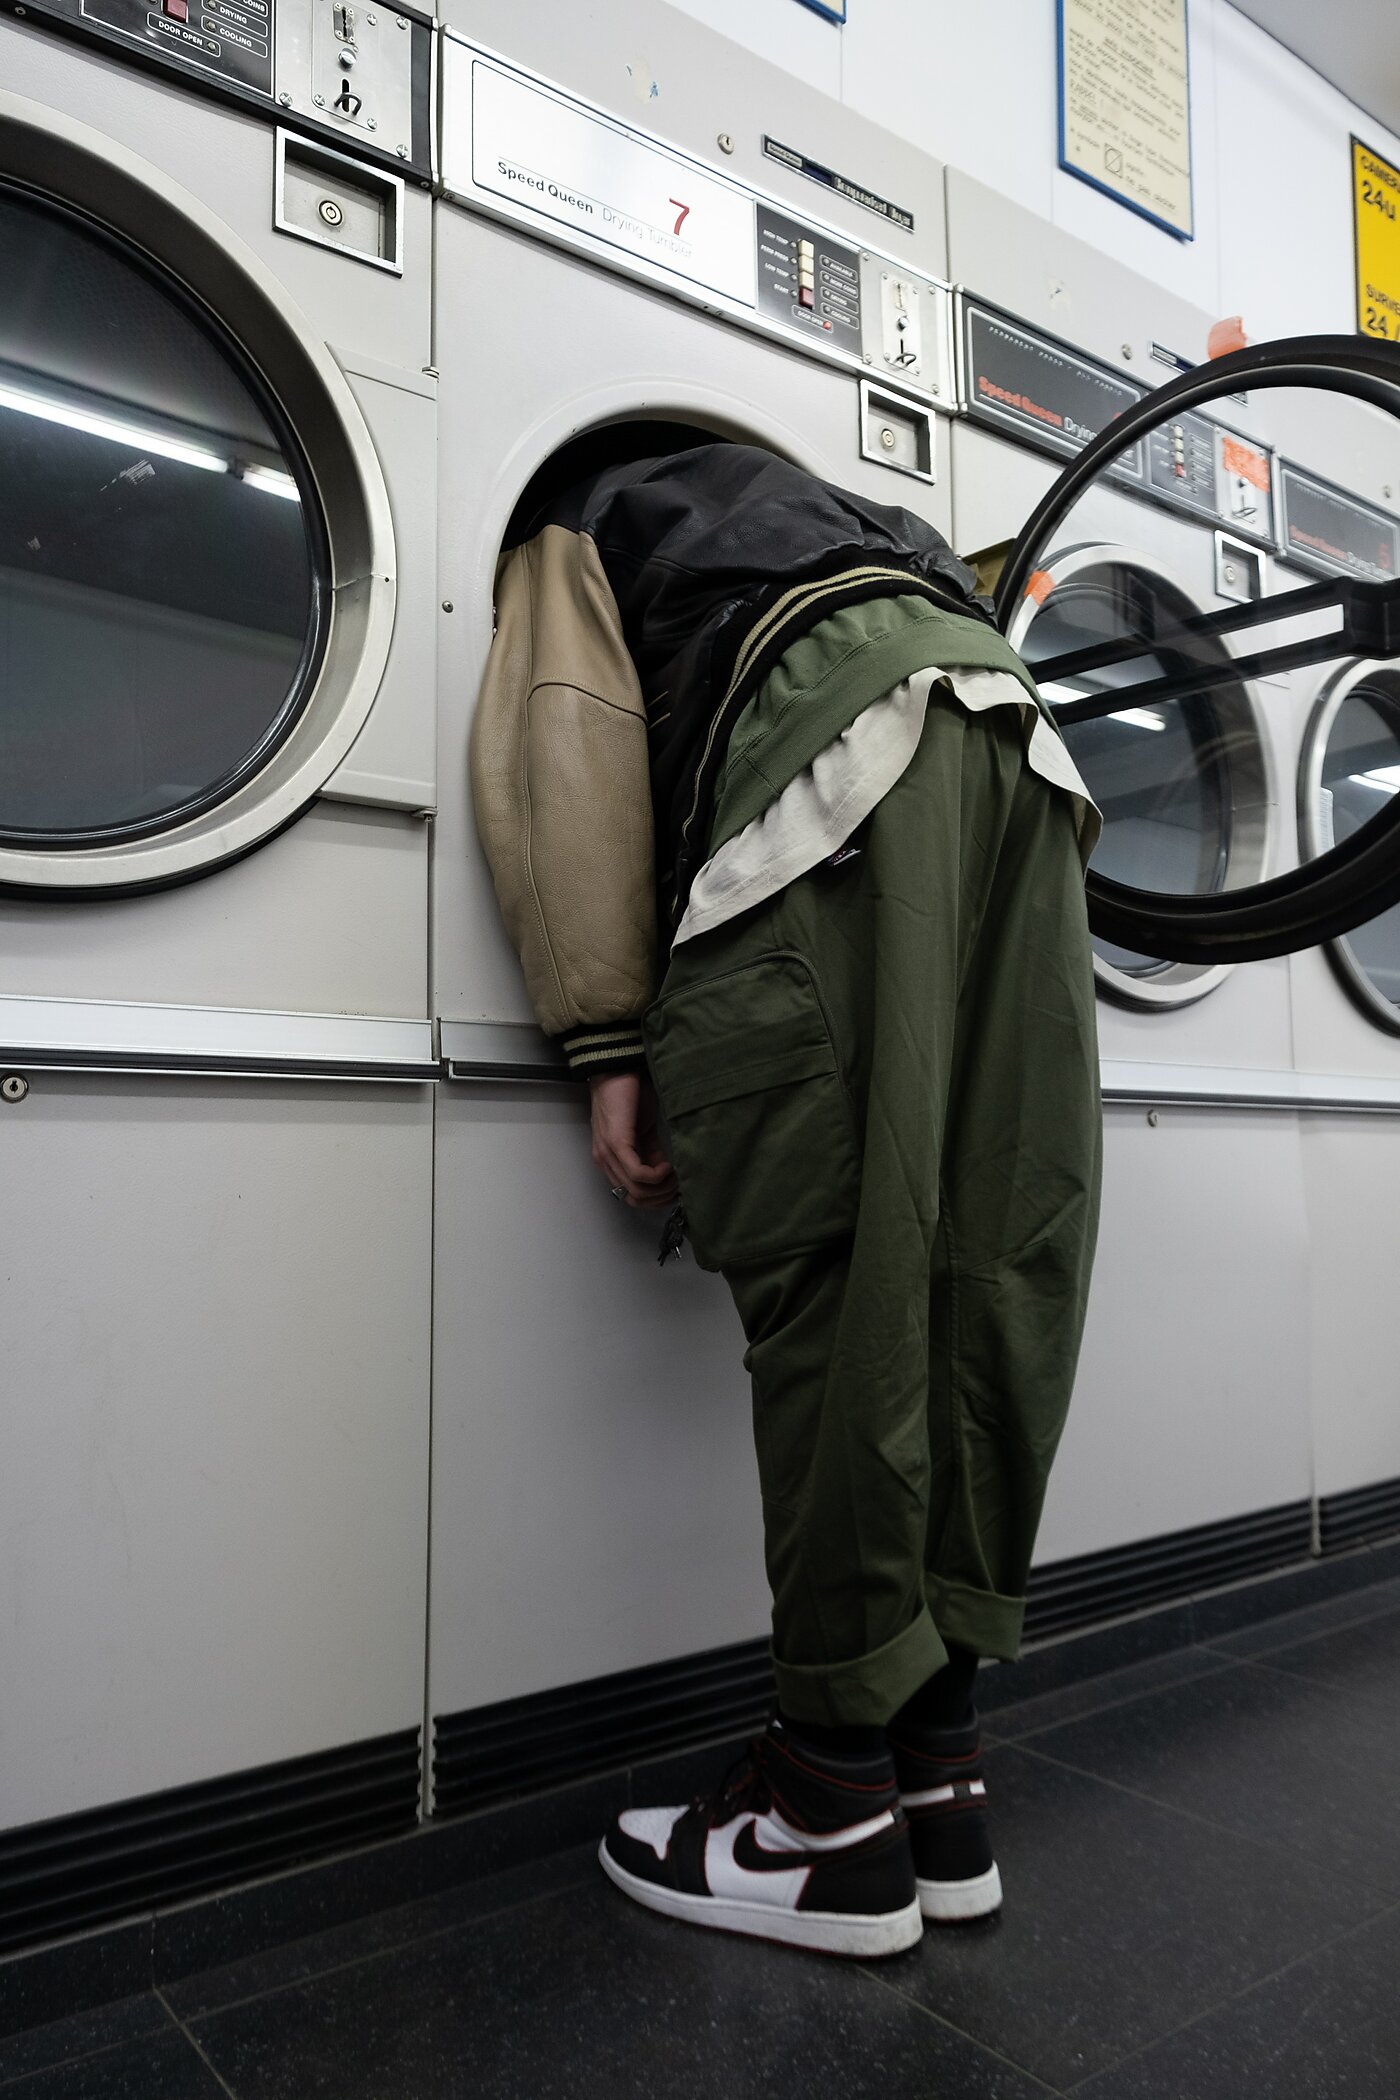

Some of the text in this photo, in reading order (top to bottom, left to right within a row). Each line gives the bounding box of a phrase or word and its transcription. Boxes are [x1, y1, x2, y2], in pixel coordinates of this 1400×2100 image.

[219, 6, 247, 24] DRYING
[158, 20, 203, 46] DOOR OPEN
[219, 27, 252, 47] COOLING
[1361, 156, 1400, 193] CAMER
[498, 161, 544, 192] Speed
[548, 184, 593, 214] Queen
[602, 207, 643, 239] Drying
[668, 198, 690, 236] 7
